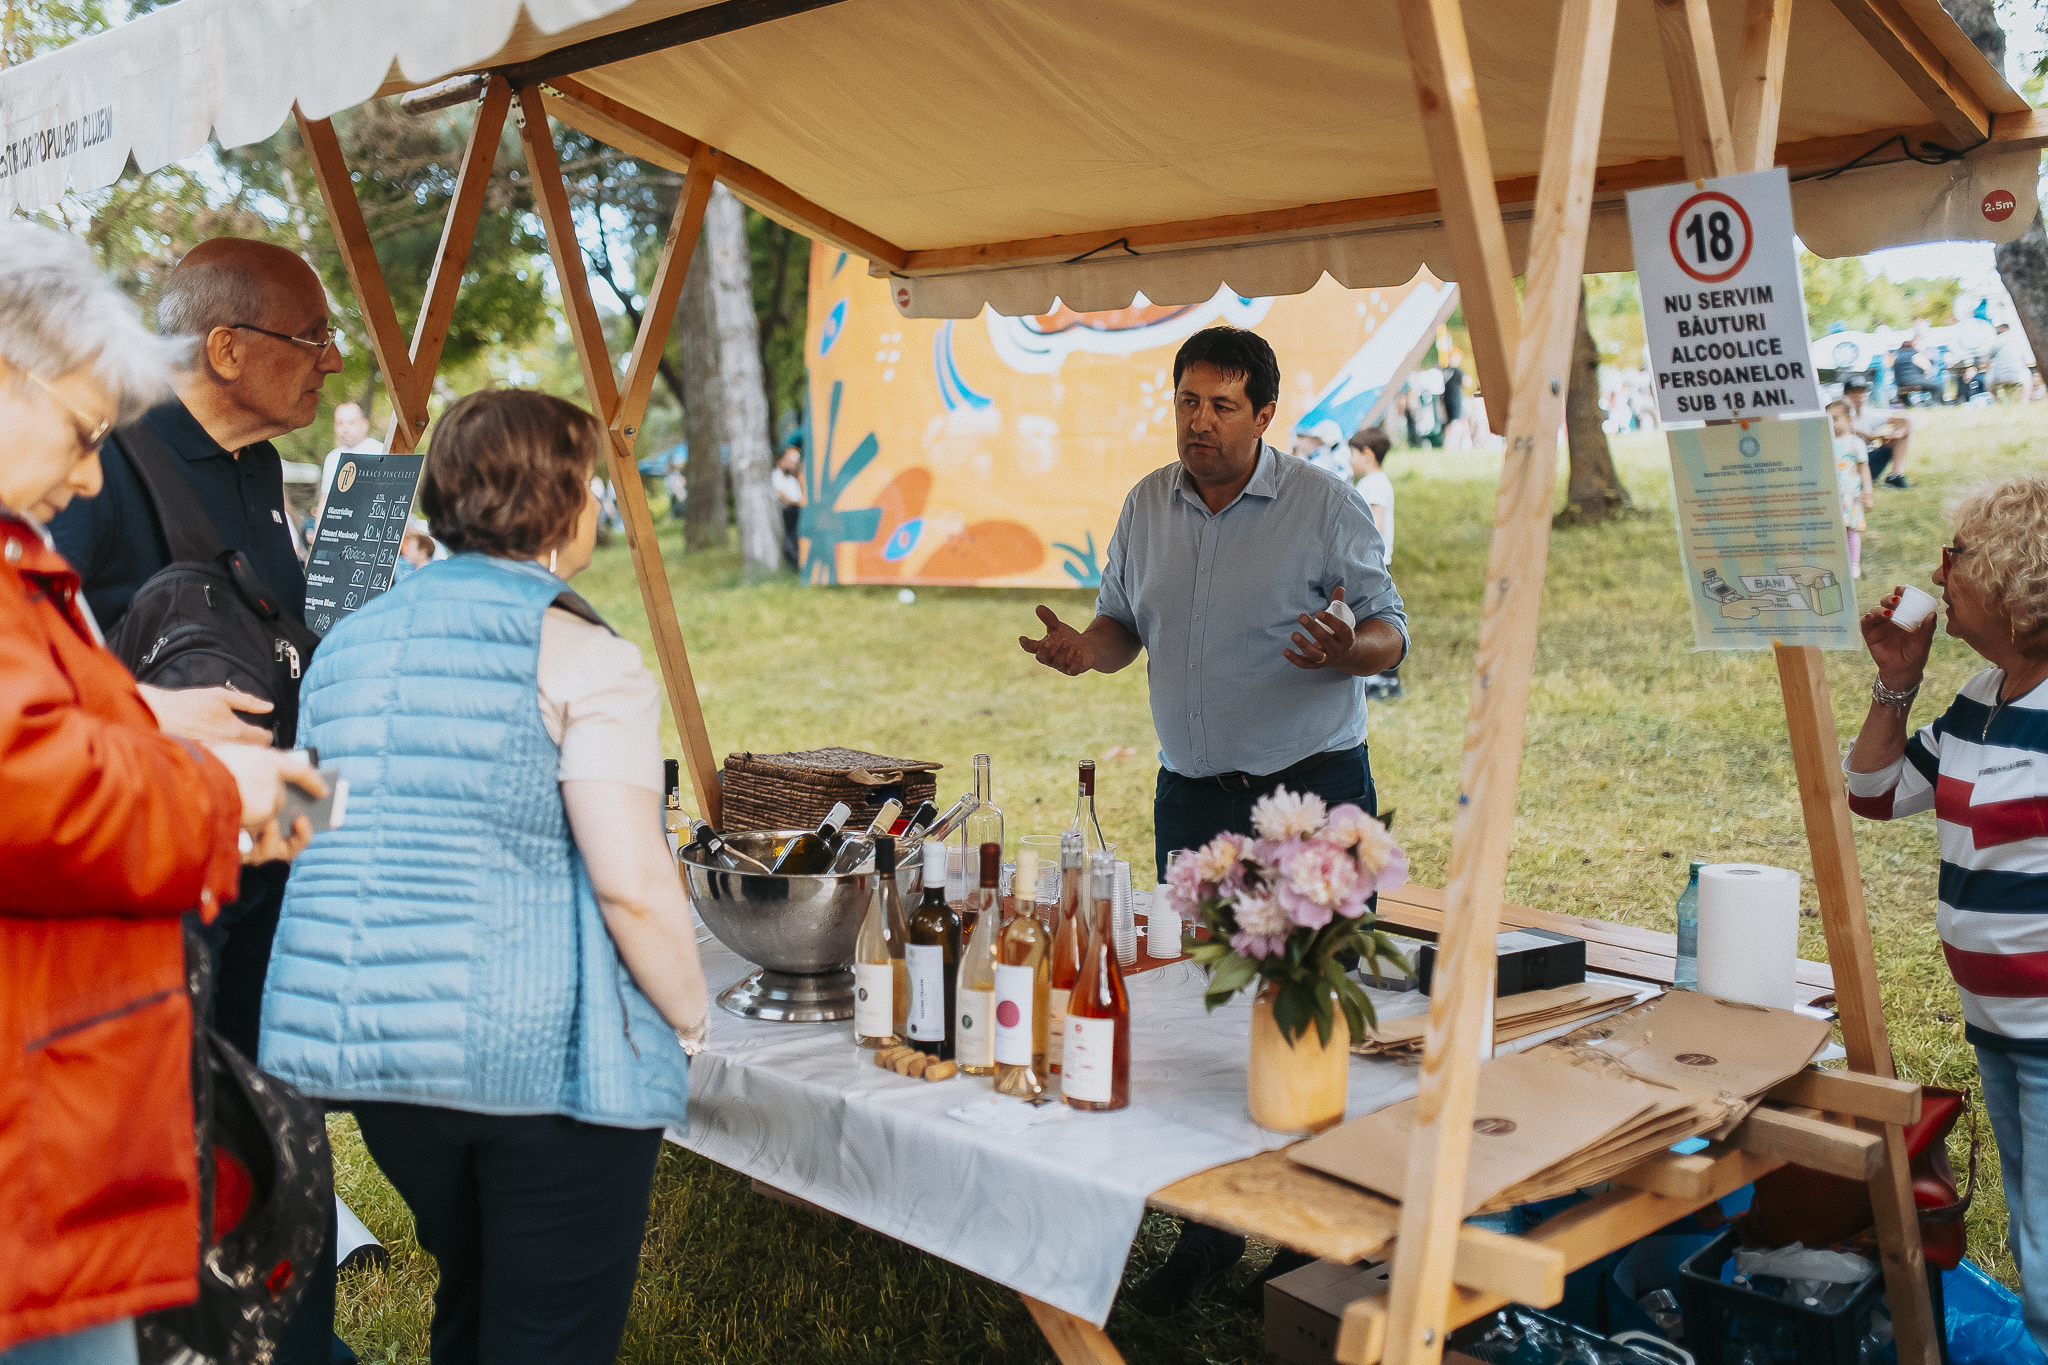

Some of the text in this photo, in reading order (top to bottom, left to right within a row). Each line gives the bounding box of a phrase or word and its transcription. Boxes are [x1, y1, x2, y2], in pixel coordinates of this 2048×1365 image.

[34, 120, 79, 166] POPULARI
[82, 104, 113, 149] CLUJENI
[1984, 201, 2014, 212] 2.5m
[1686, 211, 1734, 263] 18
[1664, 285, 1774, 314] NU SERVIM
[1678, 313, 1767, 338] BĂUTURI
[1672, 338, 1783, 364] ALCOOLICE
[1660, 362, 1804, 389] PERSOANELOR
[1677, 388, 1795, 413] SUB 18 ANI.
[391, 504, 400, 516] 10
[386, 525, 393, 540] 8
[1755, 579, 1785, 588] BANI
[344, 591, 358, 608] 60
